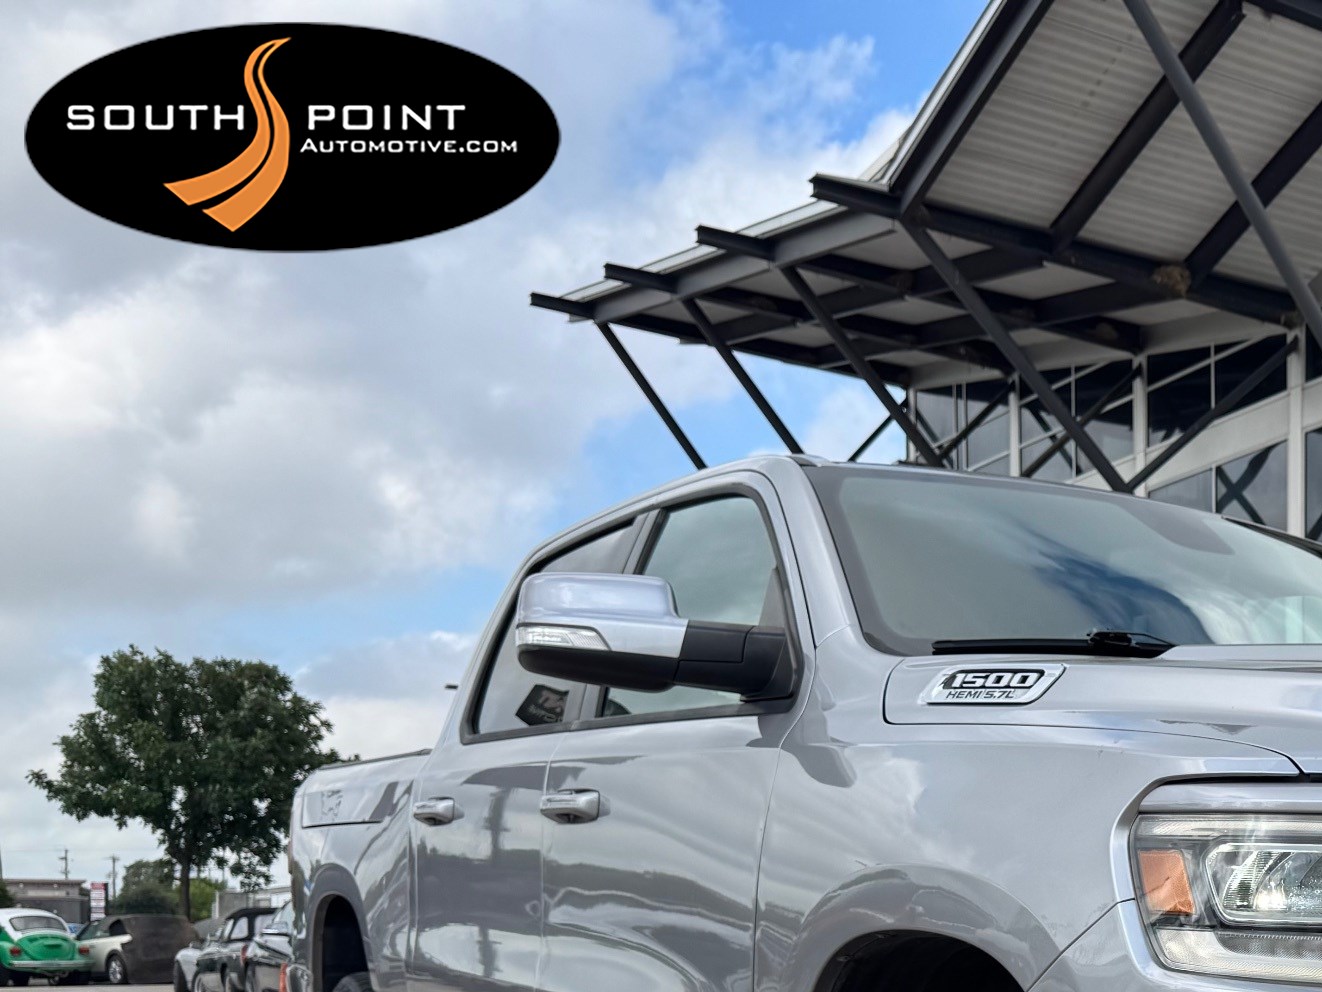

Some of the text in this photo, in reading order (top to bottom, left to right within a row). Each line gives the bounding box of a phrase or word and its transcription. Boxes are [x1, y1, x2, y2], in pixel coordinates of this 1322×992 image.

[952, 672, 1039, 688] 1500
[946, 690, 1014, 699] HEMI 5.7L
